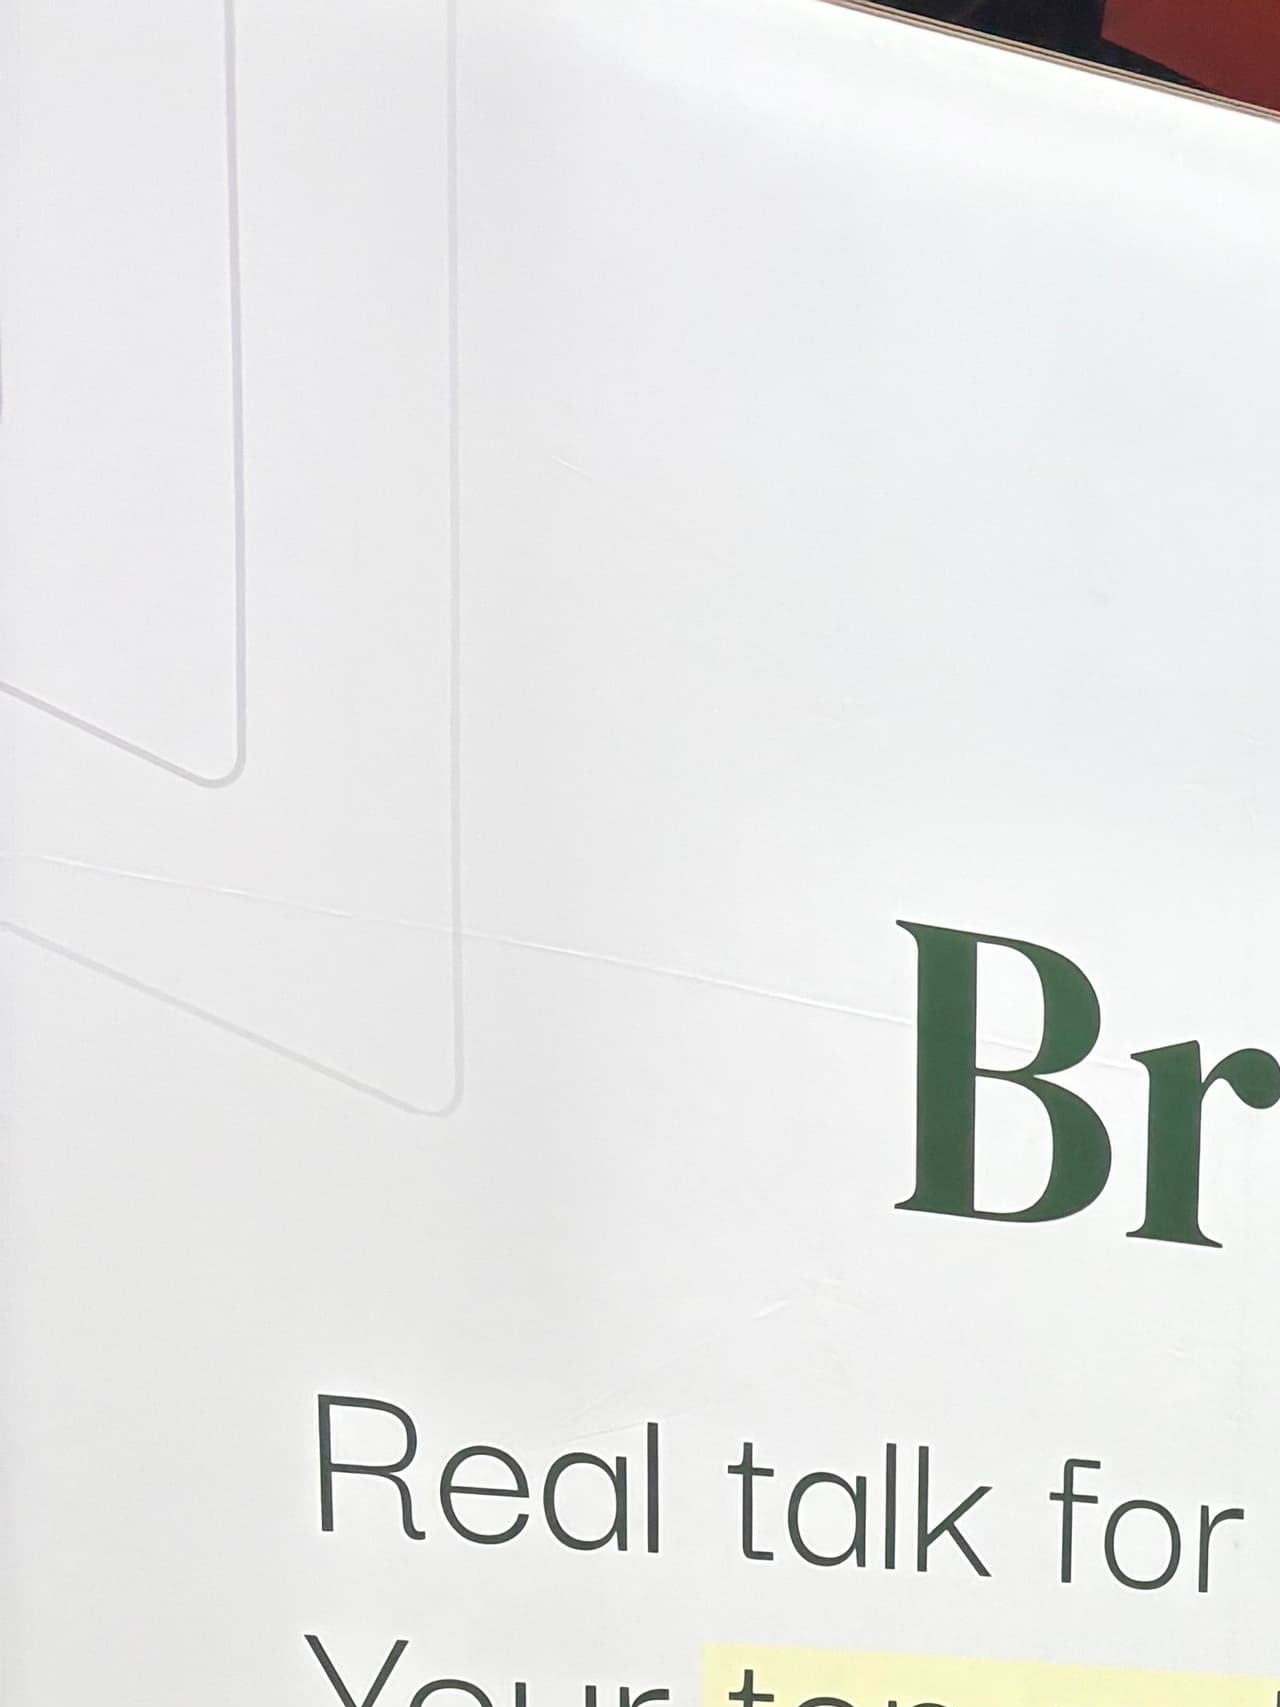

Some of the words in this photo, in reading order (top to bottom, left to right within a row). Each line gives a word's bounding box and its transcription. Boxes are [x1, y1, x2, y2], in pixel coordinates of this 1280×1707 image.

[317, 1393, 659, 1554] Real
[727, 1441, 993, 1577] talk
[1049, 1458, 1245, 1593] for
